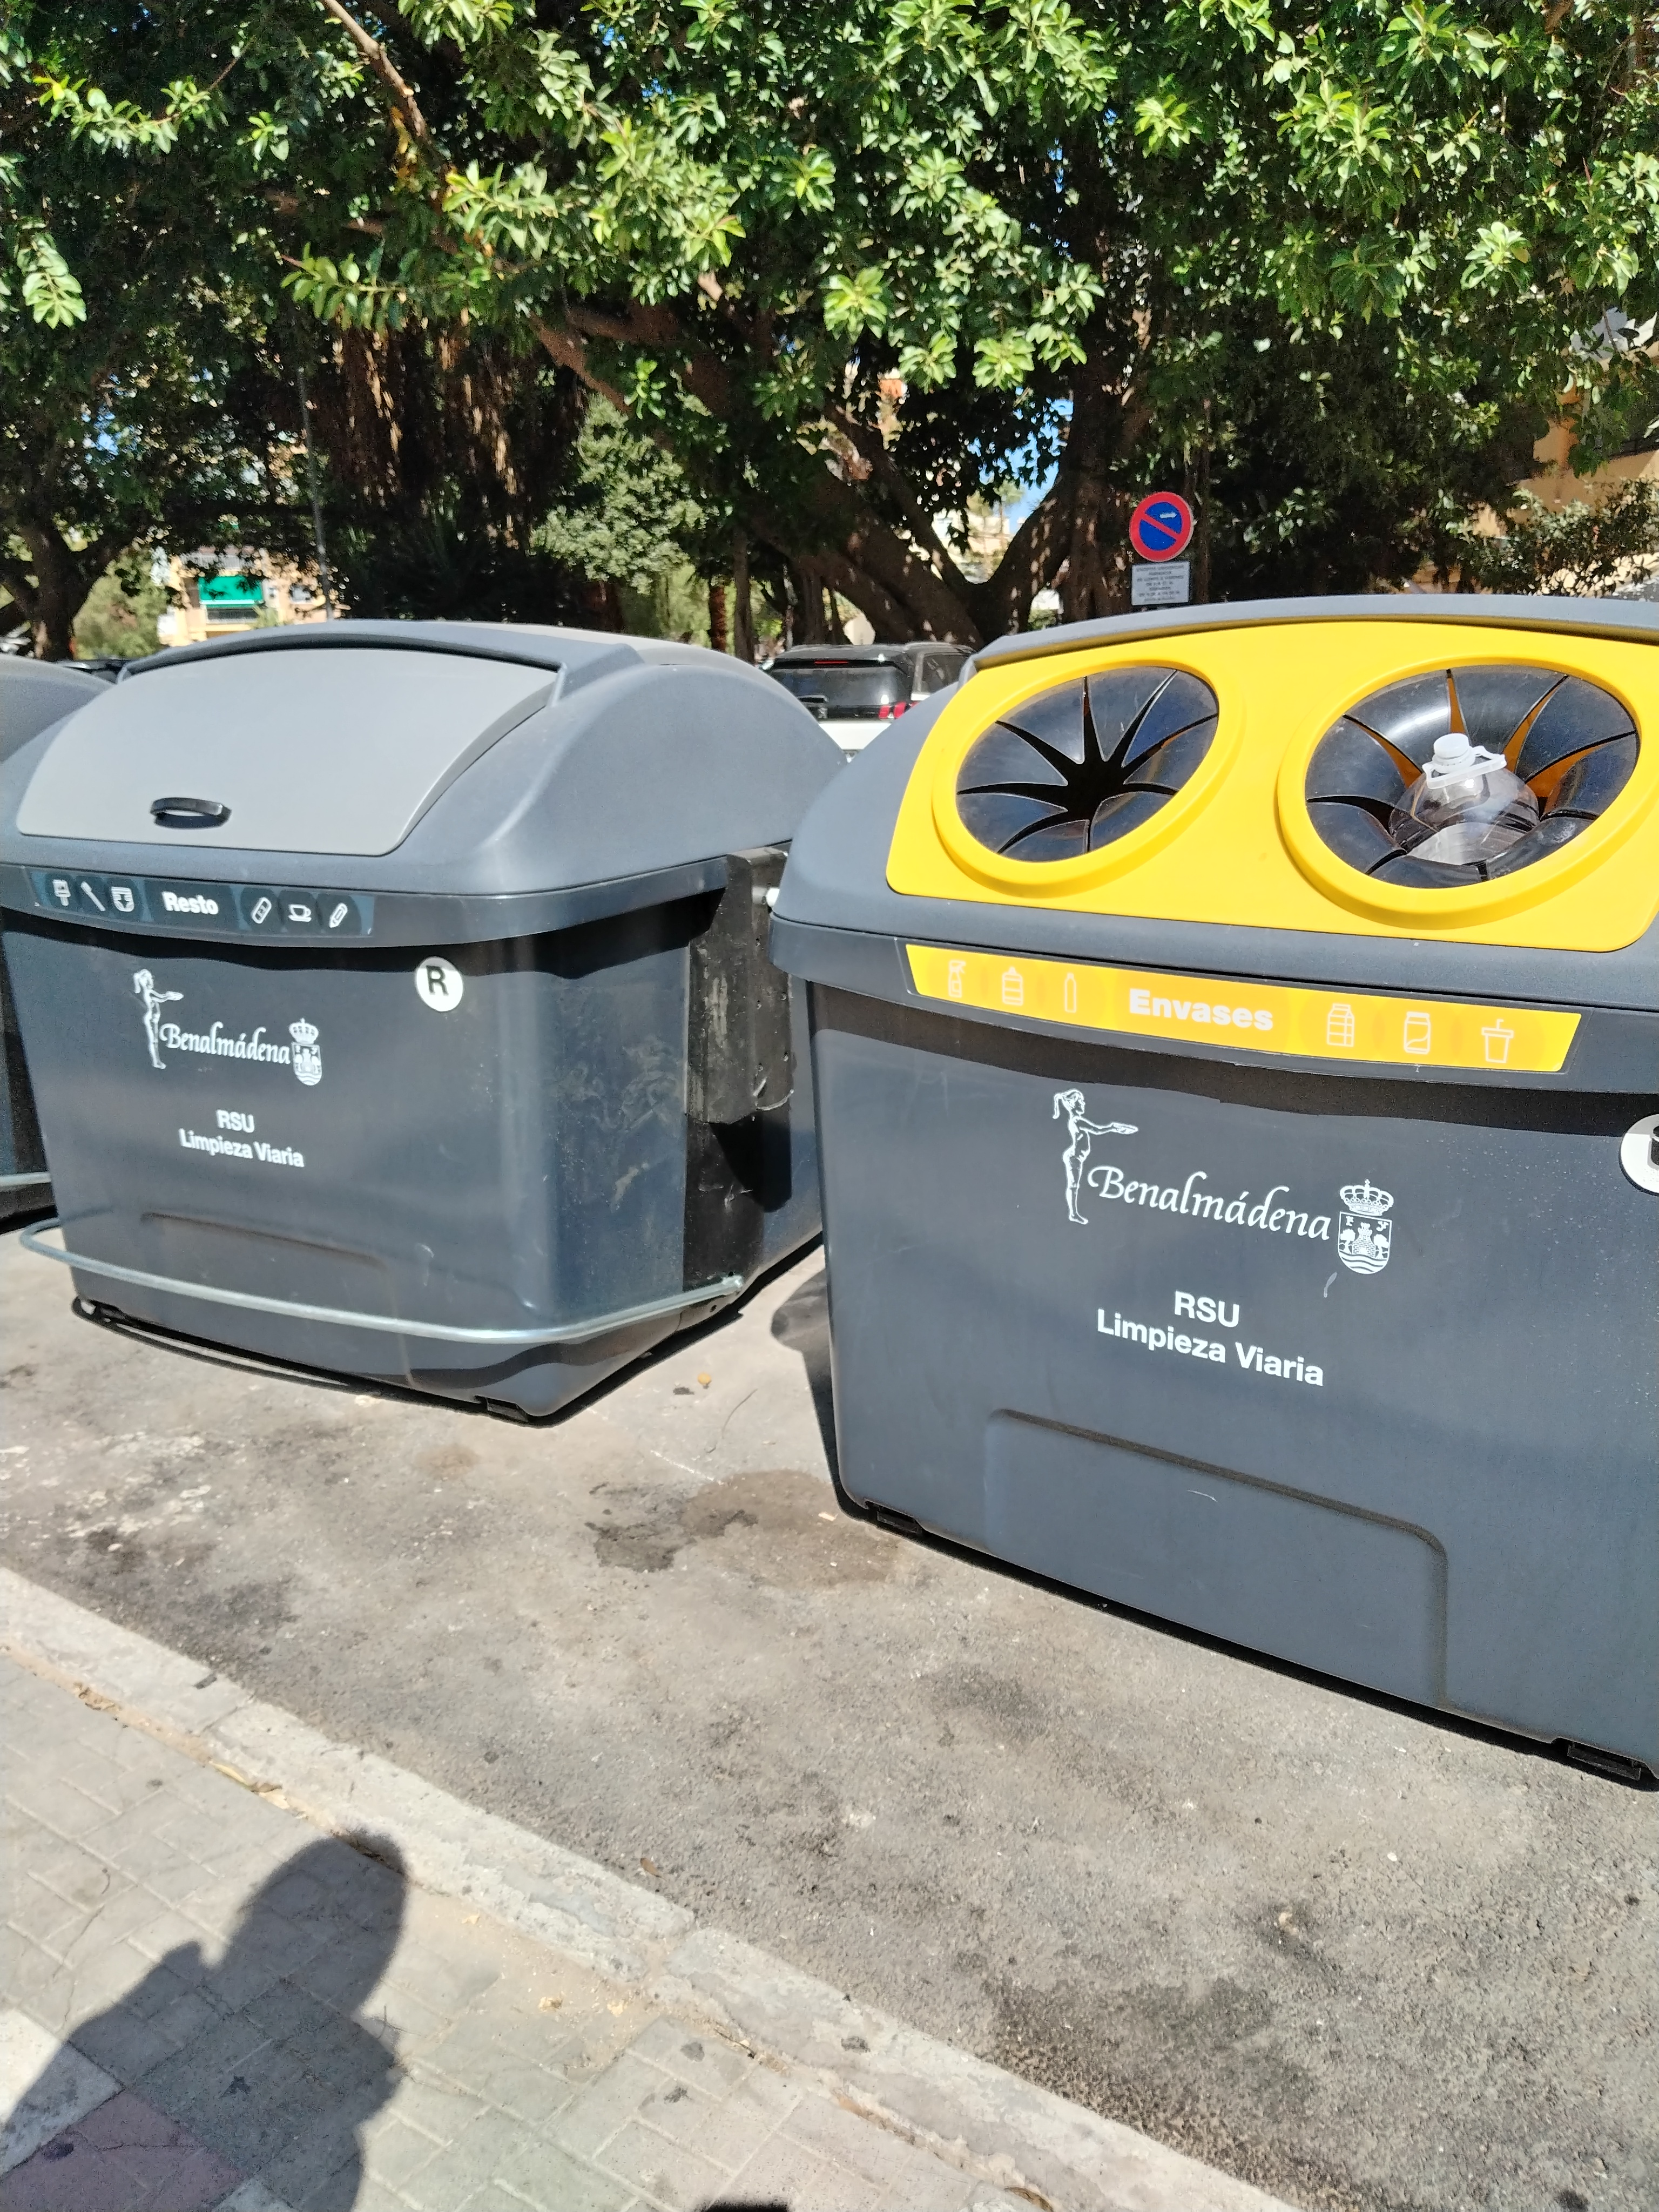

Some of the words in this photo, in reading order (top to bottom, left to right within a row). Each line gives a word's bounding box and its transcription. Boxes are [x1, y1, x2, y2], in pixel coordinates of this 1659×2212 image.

[161, 891, 219, 915] Resto
[426, 965, 449, 997] R
[1128, 987, 1274, 1031] Envases
[158, 1021, 292, 1065] Benalmádena
[215, 1109, 255, 1134] RSU
[178, 1128, 253, 1159] Limpieza
[252, 1141, 306, 1168] Viaria
[1087, 1165, 1332, 1241] Benalmádena
[1174, 1290, 1240, 1328] RSU
[1097, 1308, 1226, 1364] Limpieza
[1235, 1341, 1324, 1387] Viaria
